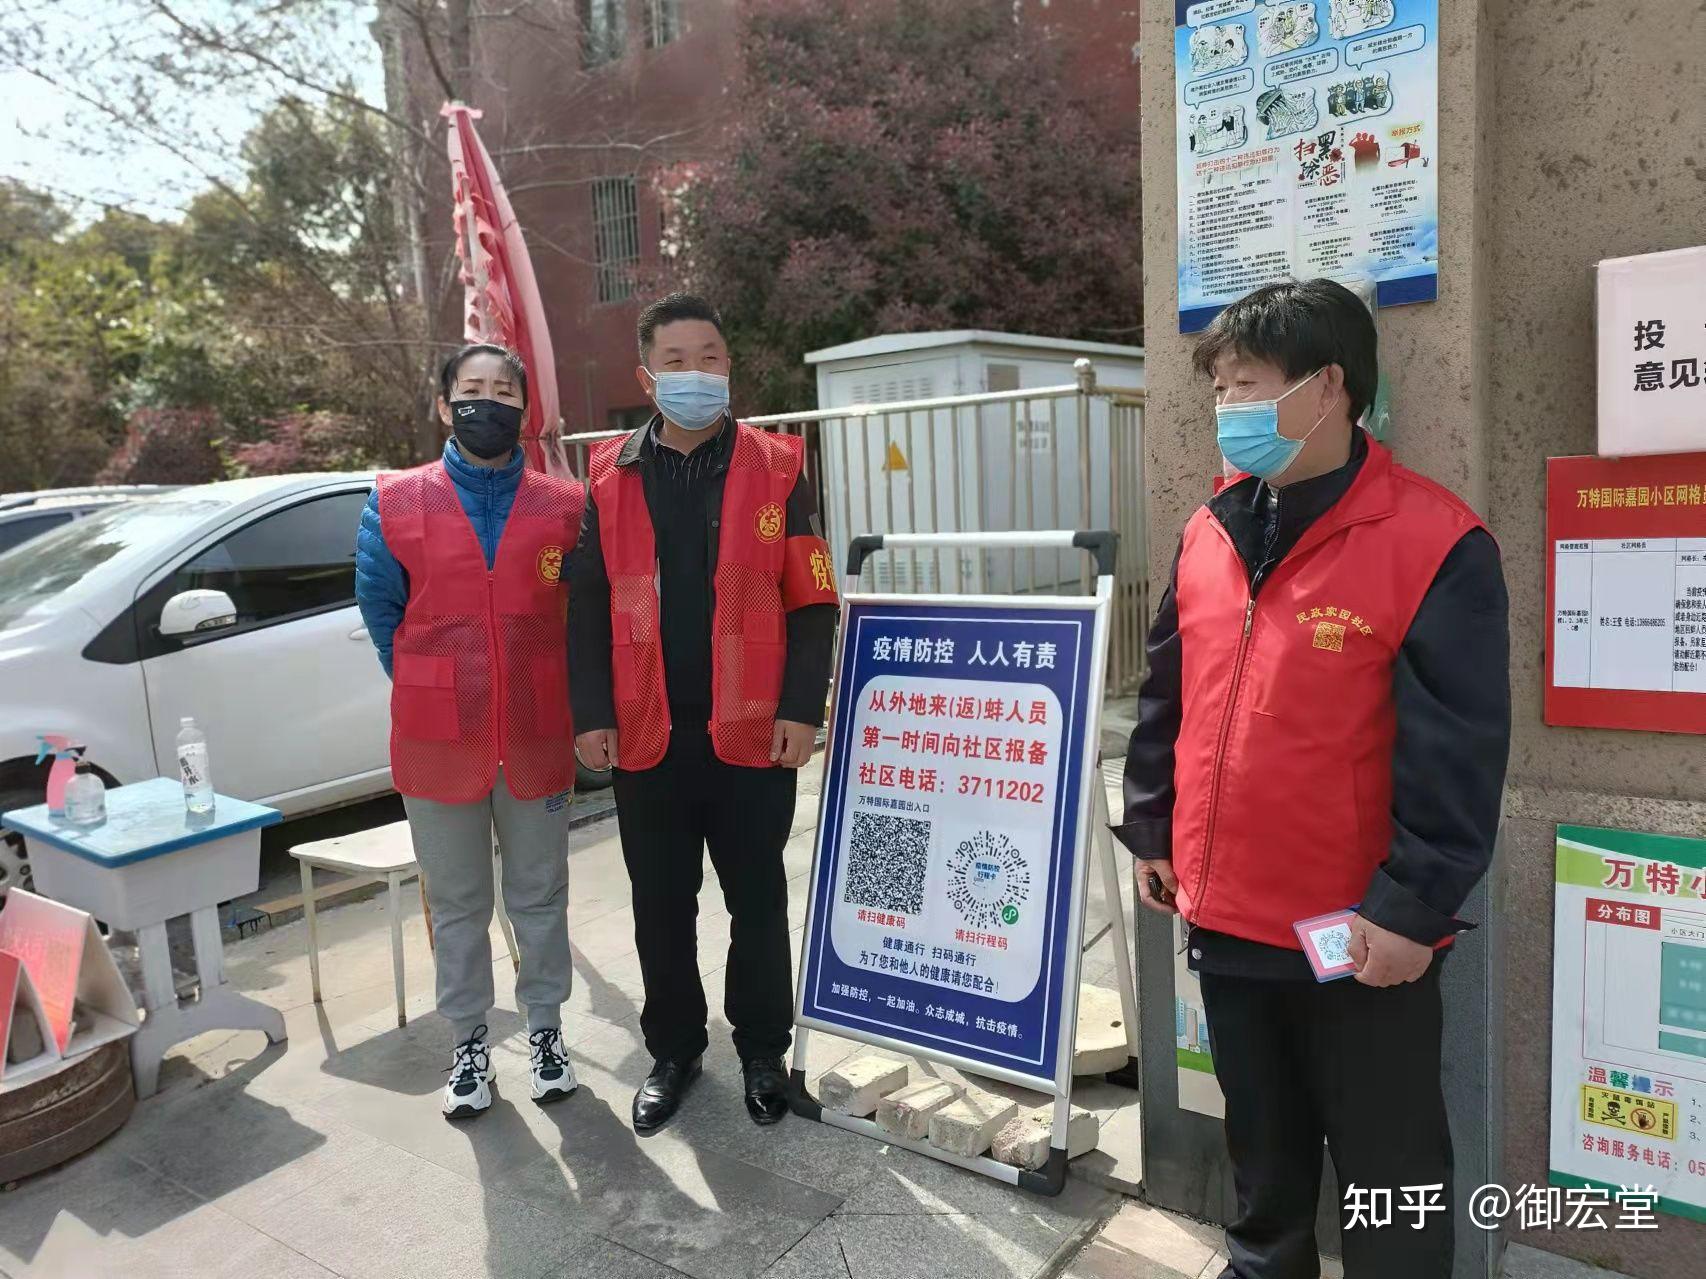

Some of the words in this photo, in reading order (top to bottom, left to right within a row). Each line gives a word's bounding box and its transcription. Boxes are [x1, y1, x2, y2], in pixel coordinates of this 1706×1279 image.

[1633, 319, 1665, 351] 投
[1633, 357, 1706, 392] 意见
[872, 636, 955, 664] 疫情防控
[967, 640, 1057, 669] 人人有责
[869, 689, 1048, 726] 从外地来(返)蚌人员
[862, 725, 1049, 766] 第一时间向社区报备
[858, 795, 930, 814] 万特国际嘉园出入口
[857, 909, 906, 929] 请扫健康码
[1597, 904, 1650, 925] 分布图
[955, 928, 1008, 950] 请扫行程码
[1671, 927, 1705, 939] 小区大门
[882, 936, 927, 956] 健康通行
[931, 946, 977, 967] 扫码通行
